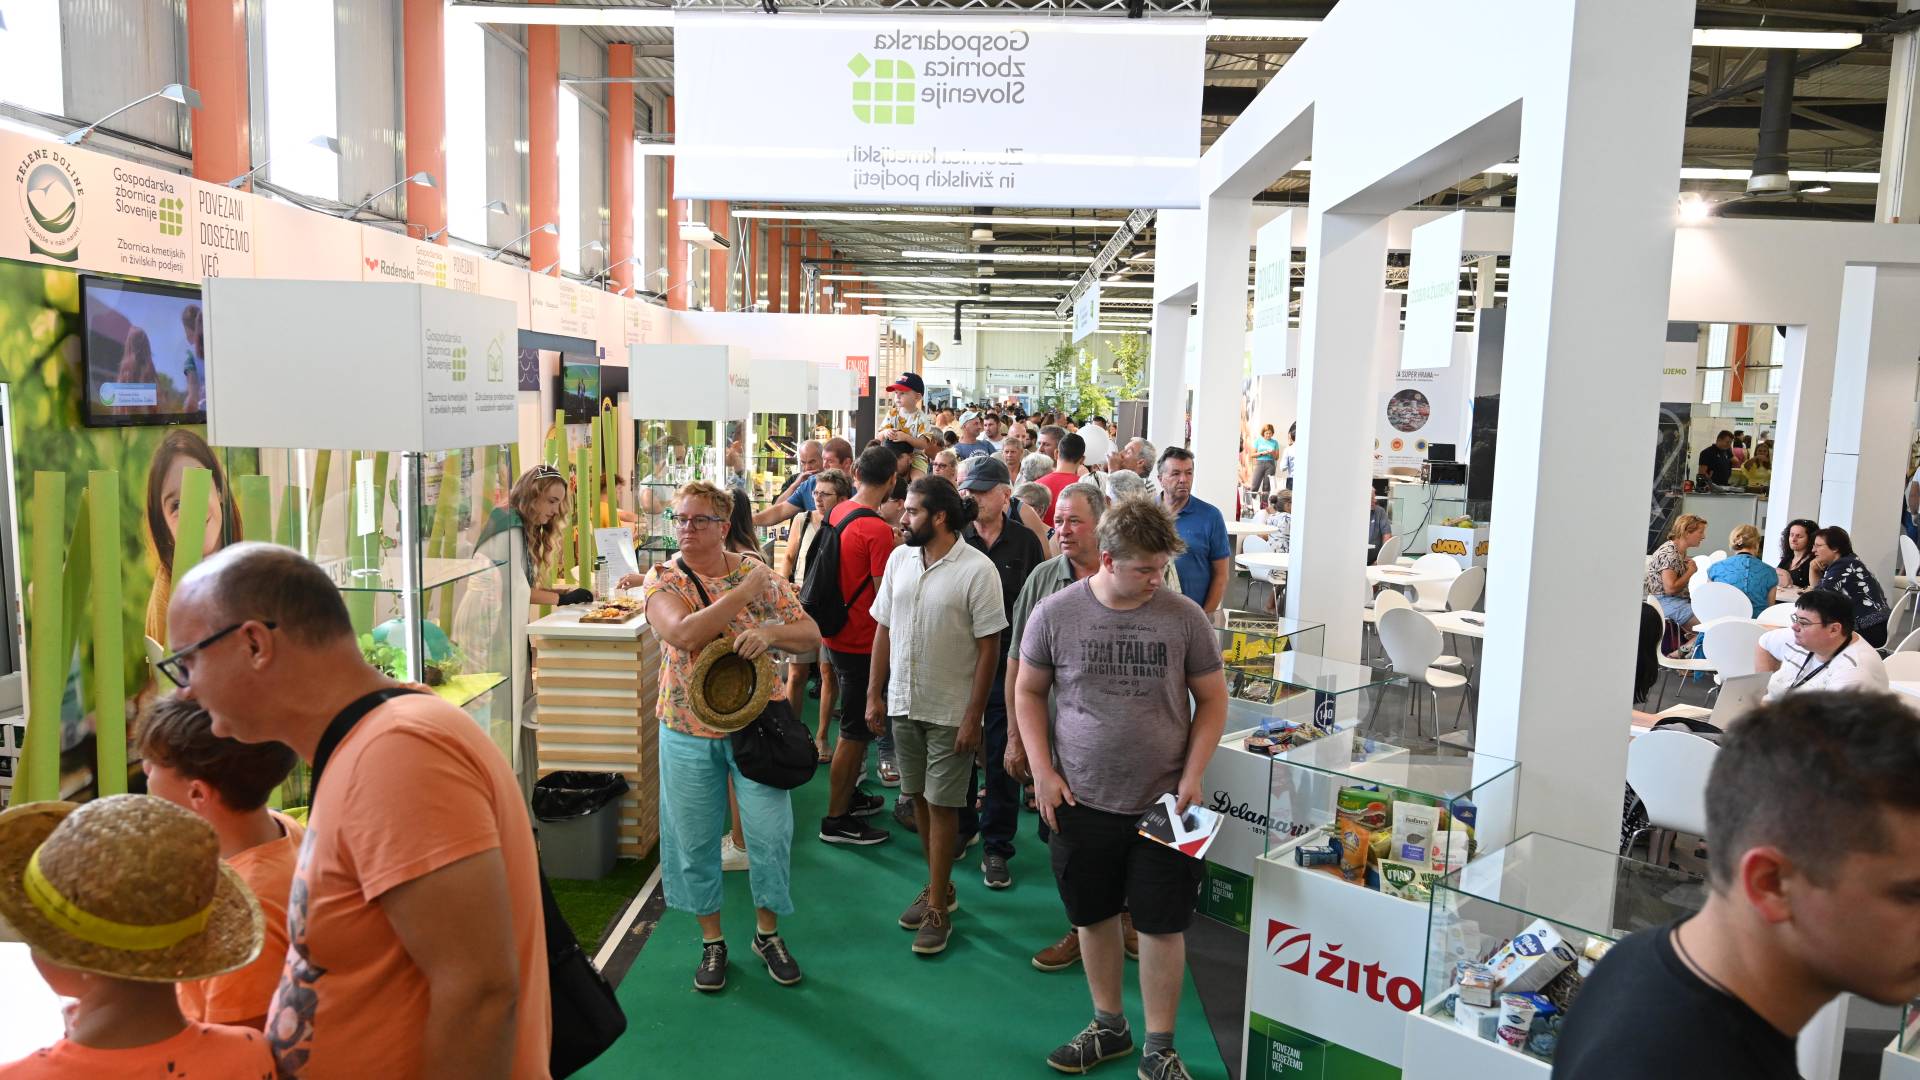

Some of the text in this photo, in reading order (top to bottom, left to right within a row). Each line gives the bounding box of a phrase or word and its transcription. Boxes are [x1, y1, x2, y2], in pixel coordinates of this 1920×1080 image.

[16, 148, 85, 197] ZELENE DOLINE
[113, 167, 174, 194] Gospodarska
[115, 185, 156, 205] zbornica
[199, 190, 244, 222] POVEZANI
[115, 199, 157, 221] Slovenije
[200, 221, 250, 253] DOSEŽEMO
[117, 238, 186, 260] Zbornica kmetijskih
[120, 252, 184, 274] in živilskih podjetij
[201, 253, 220, 277] VEČ
[380, 259, 415, 280] Radenska
[1081, 639, 1168, 667] TOM TAILOR
[1316, 942, 1422, 1012] žito
[1272, 1041, 1301, 1060] POVEZANI
[1272, 1050, 1303, 1071] DOSEŽEMO
[1271, 1060, 1283, 1073] VEČ
